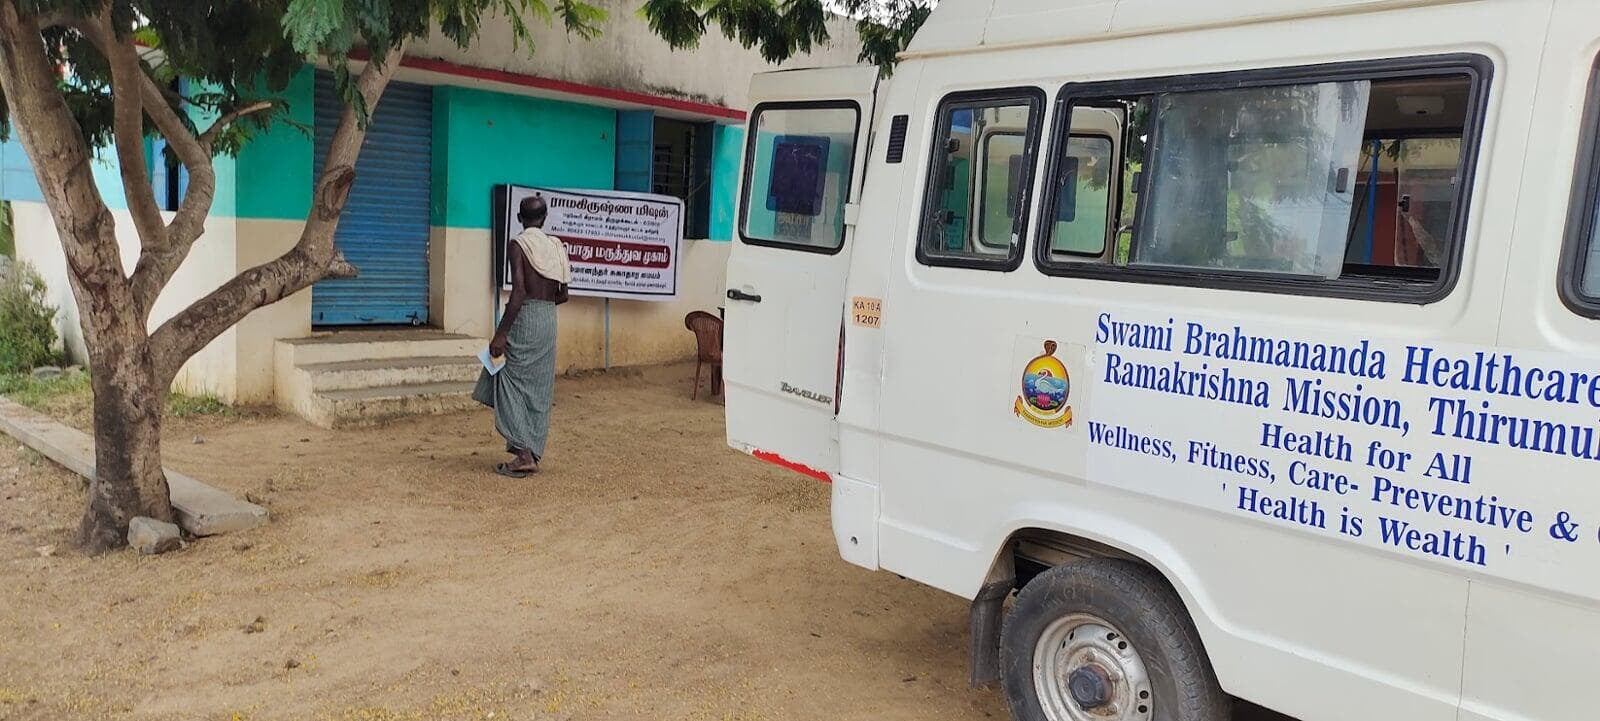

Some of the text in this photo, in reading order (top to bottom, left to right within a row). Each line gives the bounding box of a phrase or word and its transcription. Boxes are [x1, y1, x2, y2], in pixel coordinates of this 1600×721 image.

[595, 244, 641, 264] மருத்துவ
[855, 301, 865, 310] KA
[876, 303, 881, 312] A
[856, 314, 879, 325] 1207
[1095, 313, 1173, 351] Swami
[1184, 322, 1385, 379] Brahmananda
[1104, 353, 1600, 461] Ramakrishna Mission, Thirumu
[1088, 422, 1177, 463] Wellness,
[1187, 441, 1276, 483] Fitness,
[1289, 461, 1359, 495] Care-
[1371, 476, 1533, 533] Preventive
[1549, 511, 1579, 542] &
[1260, 423, 1471, 484] Health for All
[1237, 486, 1326, 529] Health
[1339, 507, 1363, 537] is
[1379, 517, 1486, 566] Wealth
